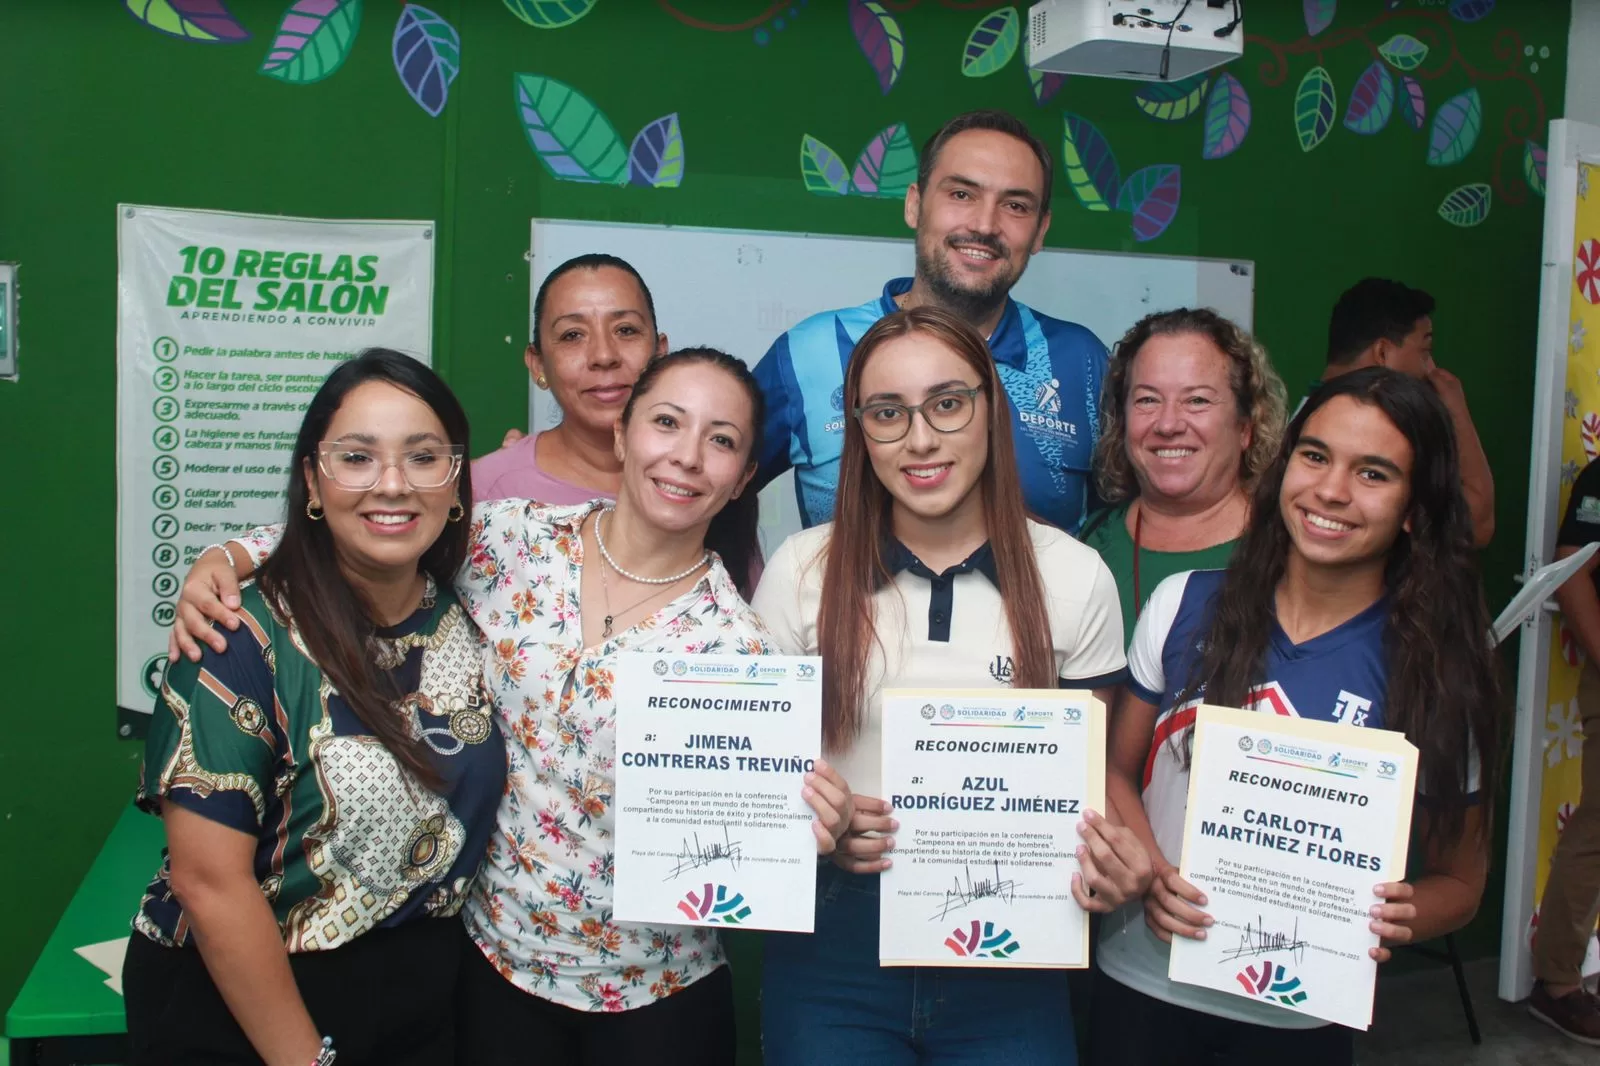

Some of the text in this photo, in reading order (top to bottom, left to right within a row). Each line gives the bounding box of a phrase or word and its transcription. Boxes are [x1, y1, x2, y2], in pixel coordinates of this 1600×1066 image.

[178, 246, 379, 283] 10 REGLAS
[166, 275, 243, 310] DEL
[180, 310, 376, 328] APRENDIENDO A CONVIVIR
[184, 346, 320, 360] Pedir la palabra antes de
[184, 370, 216, 380] Hacer
[218, 371, 229, 380] la
[266, 374, 283, 382] ser
[193, 382, 203, 390] lo
[206, 382, 235, 392] largo
[238, 382, 256, 392] del
[258, 384, 283, 392] ciclo
[184, 400, 250, 410] Expresarme
[262, 402, 296, 412] través
[184, 412, 240, 421] adecuado.
[1020, 412, 1076, 434] DEPORTE
[184, 429, 255, 440] La higiene es
[184, 440, 222, 448] cabeza
[225, 442, 232, 450] y
[184, 464, 230, 474] Moderar
[232, 464, 243, 474] el
[267, 466, 282, 474] de
[184, 488, 220, 498] Cuidar
[223, 490, 230, 498] y
[232, 490, 278, 500] proteger
[184, 499, 236, 508] del salón.
[184, 522, 216, 532] Decir:
[689, 665, 740, 674] SOLIDARIDAD
[648, 696, 792, 713] RECONOCIMIENTO
[957, 709, 1007, 717] SOLIDARIDAD
[644, 732, 752, 751] a: JIMENA
[915, 740, 1058, 755] RECONOCIMIENTO
[1274, 746, 1322, 761] SOLIDARIDAD
[622, 752, 815, 773] CONTRERAS TREVIÑO
[1342, 758, 1368, 768] DEPORTE
[912, 776, 1009, 792] a: AZUL
[1228, 770, 1368, 807] RECONOCIMIENTO
[648, 788, 662, 796] Por
[674, 788, 722, 798] participación
[744, 792, 788, 800] conferencia
[892, 792, 1080, 814] RODRÍGUEZ JIMÉNEZ
[623, 806, 673, 814] compartiendo
[686, 808, 714, 817] historia
[754, 812, 812, 820] profesionalismo
[661, 816, 702, 824] comunidad
[744, 820, 788, 829] solidarense.
[1222, 806, 1343, 844] a: CARLOTTA
[941, 830, 988, 838] participación
[952, 848, 980, 856] historia
[992, 849, 1012, 857] éxito
[1200, 820, 1382, 872] MARTÍNEZ FLORES
[1010, 859, 1054, 867] solidarense.
[1218, 858, 1230, 866] Por
[1244, 864, 1290, 880] participación
[1312, 880, 1354, 894] conferencia
[1190, 872, 1240, 887] compartiendo
[1253, 884, 1280, 896] historia
[1282, 890, 1291, 898] de
[1293, 894, 1311, 904] éxito
[1280, 882, 1304, 892] mundo
[1228, 888, 1267, 903] comunidad
[1269, 898, 1306, 912] estudiantil
[1308, 908, 1352, 924] solidarense.
